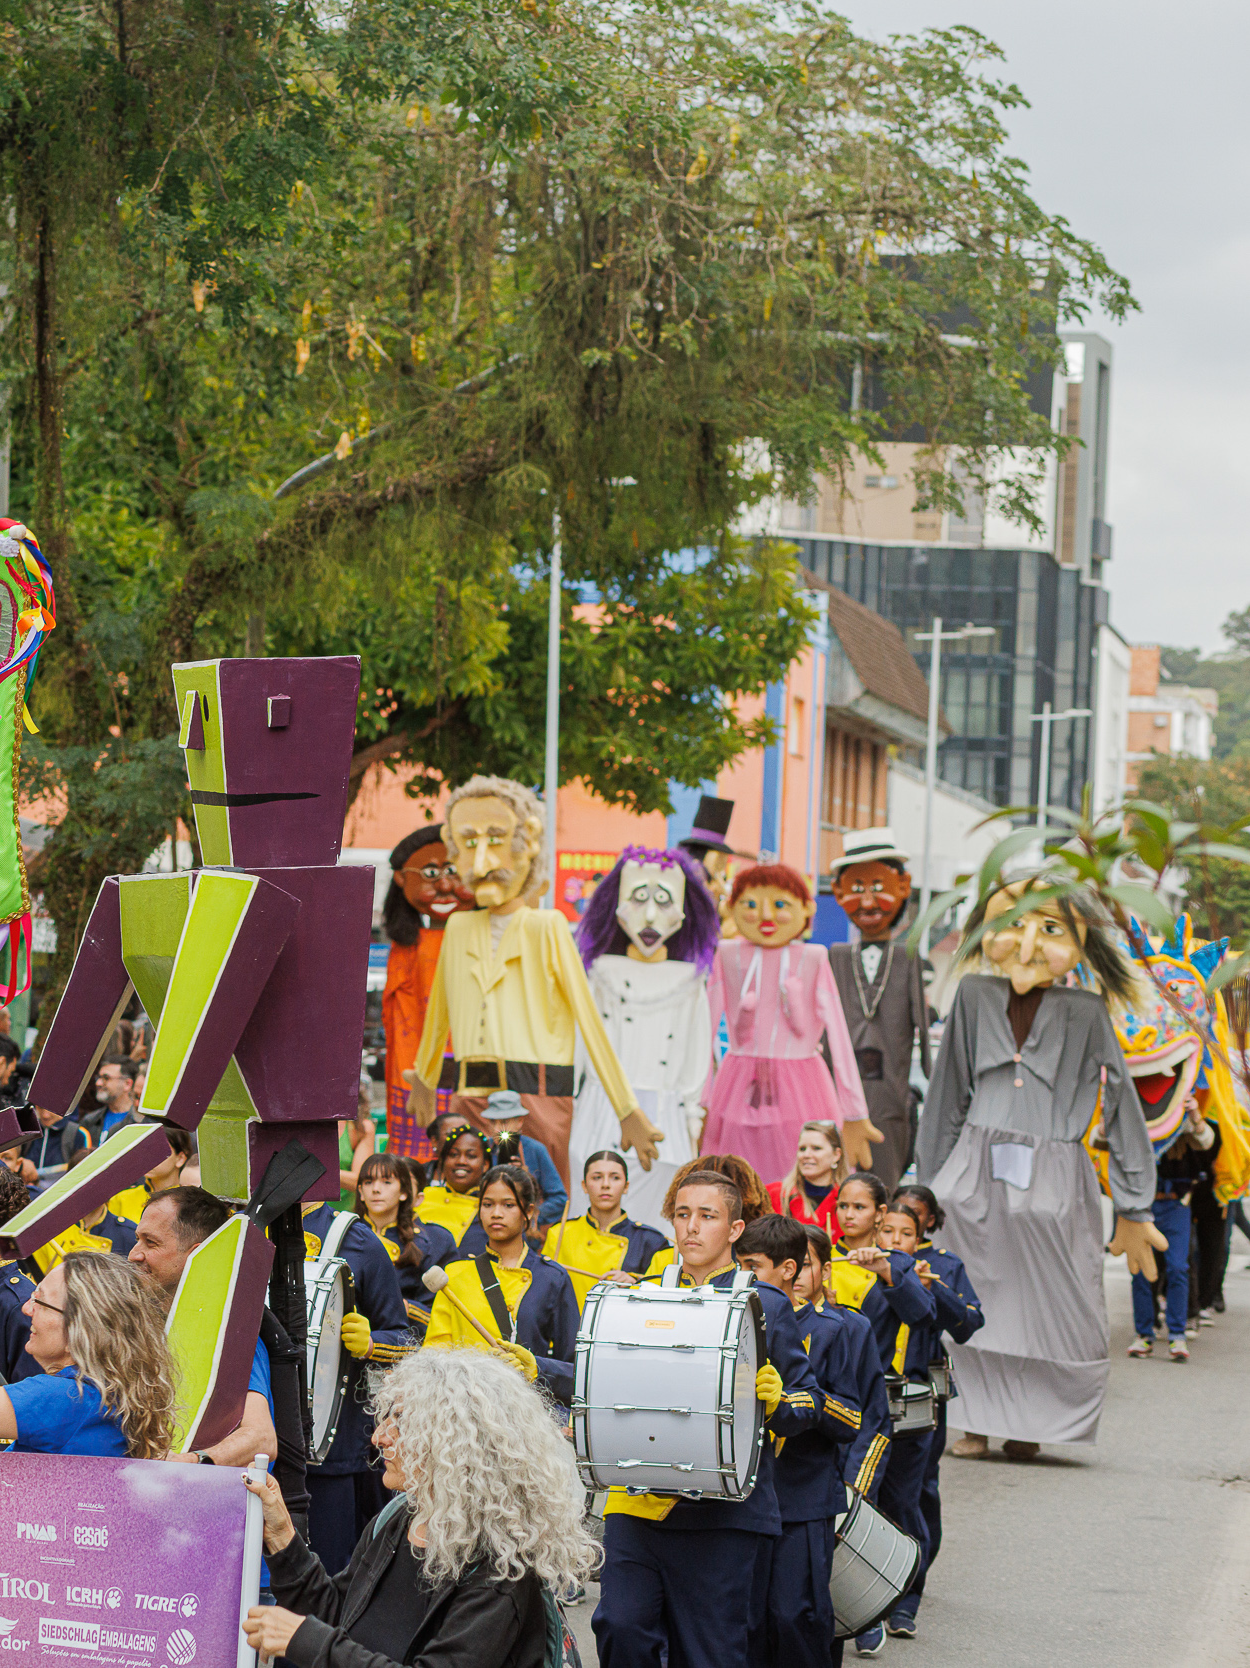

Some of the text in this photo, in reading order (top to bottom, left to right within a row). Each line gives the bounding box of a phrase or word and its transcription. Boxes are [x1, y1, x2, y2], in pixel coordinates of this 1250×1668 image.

[16, 1521, 58, 1542] PNAB
[66, 1585, 104, 1605] ICRH
[134, 1593, 179, 1613] TIGRE
[40, 1623, 157, 1653] SIEDSCHLAG EMBALAGENS
